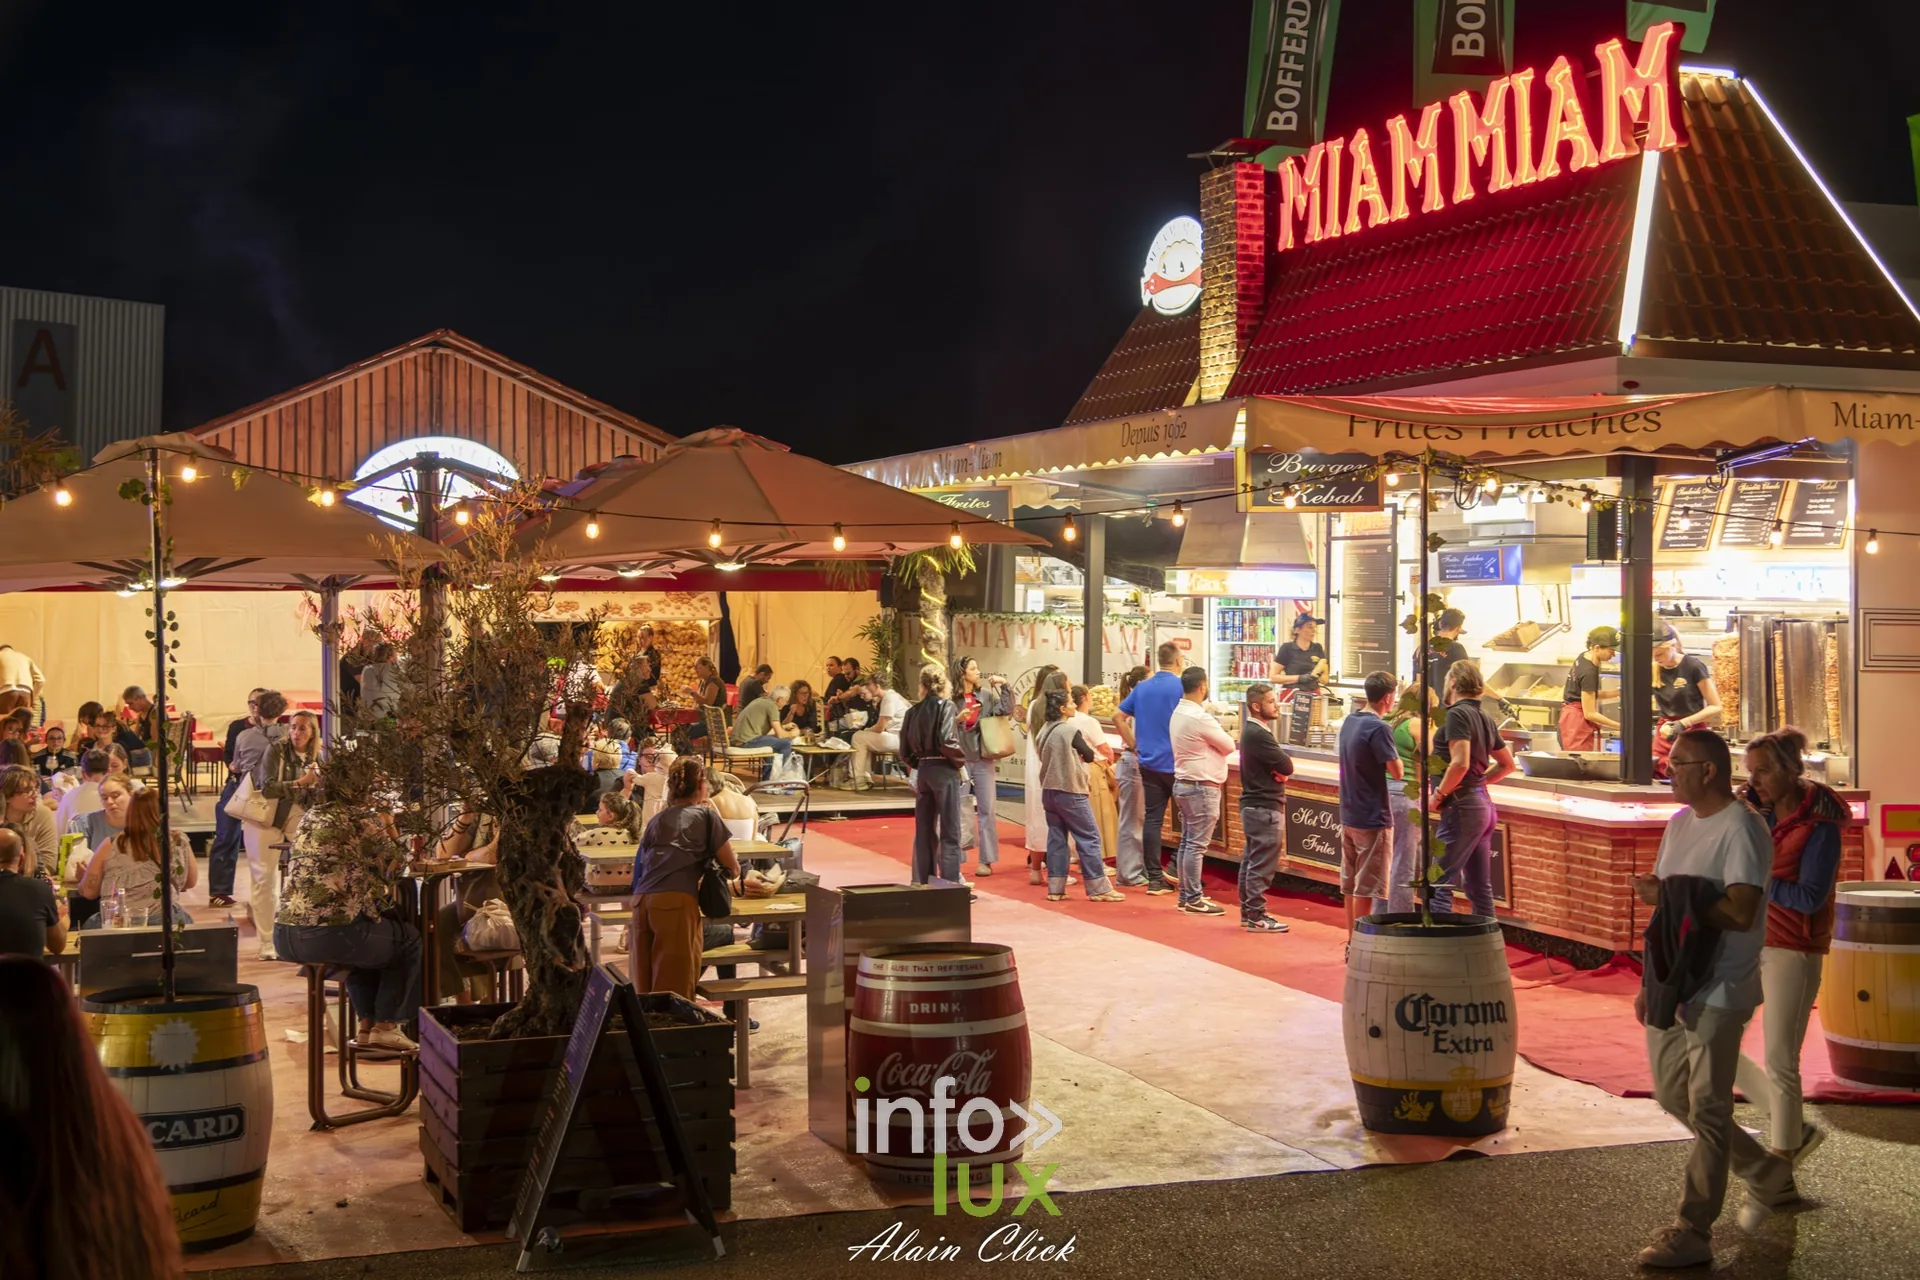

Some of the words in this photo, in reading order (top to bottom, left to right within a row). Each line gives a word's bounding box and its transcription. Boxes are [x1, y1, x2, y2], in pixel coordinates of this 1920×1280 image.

[1452, 0, 1486, 57] BO
[16, 328, 67, 391] A
[1121, 418, 1160, 454] Depuis
[1267, 452, 1367, 482] Burger
[939, 494, 991, 509] Frites
[1268, 484, 1364, 505] Kebab
[957, 620, 1142, 656] MIAM-MAM
[1291, 807, 1319, 827] Hot
[1319, 810, 1343, 838] Dog
[1302, 833, 1336, 856] Frites
[888, 964, 909, 972] AUSE
[913, 965, 934, 973] THAT
[909, 1002, 961, 1014] DRINK
[1395, 993, 1508, 1037] Corona
[1433, 1029, 1494, 1055] Extra
[145, 1114, 239, 1144] CARD
